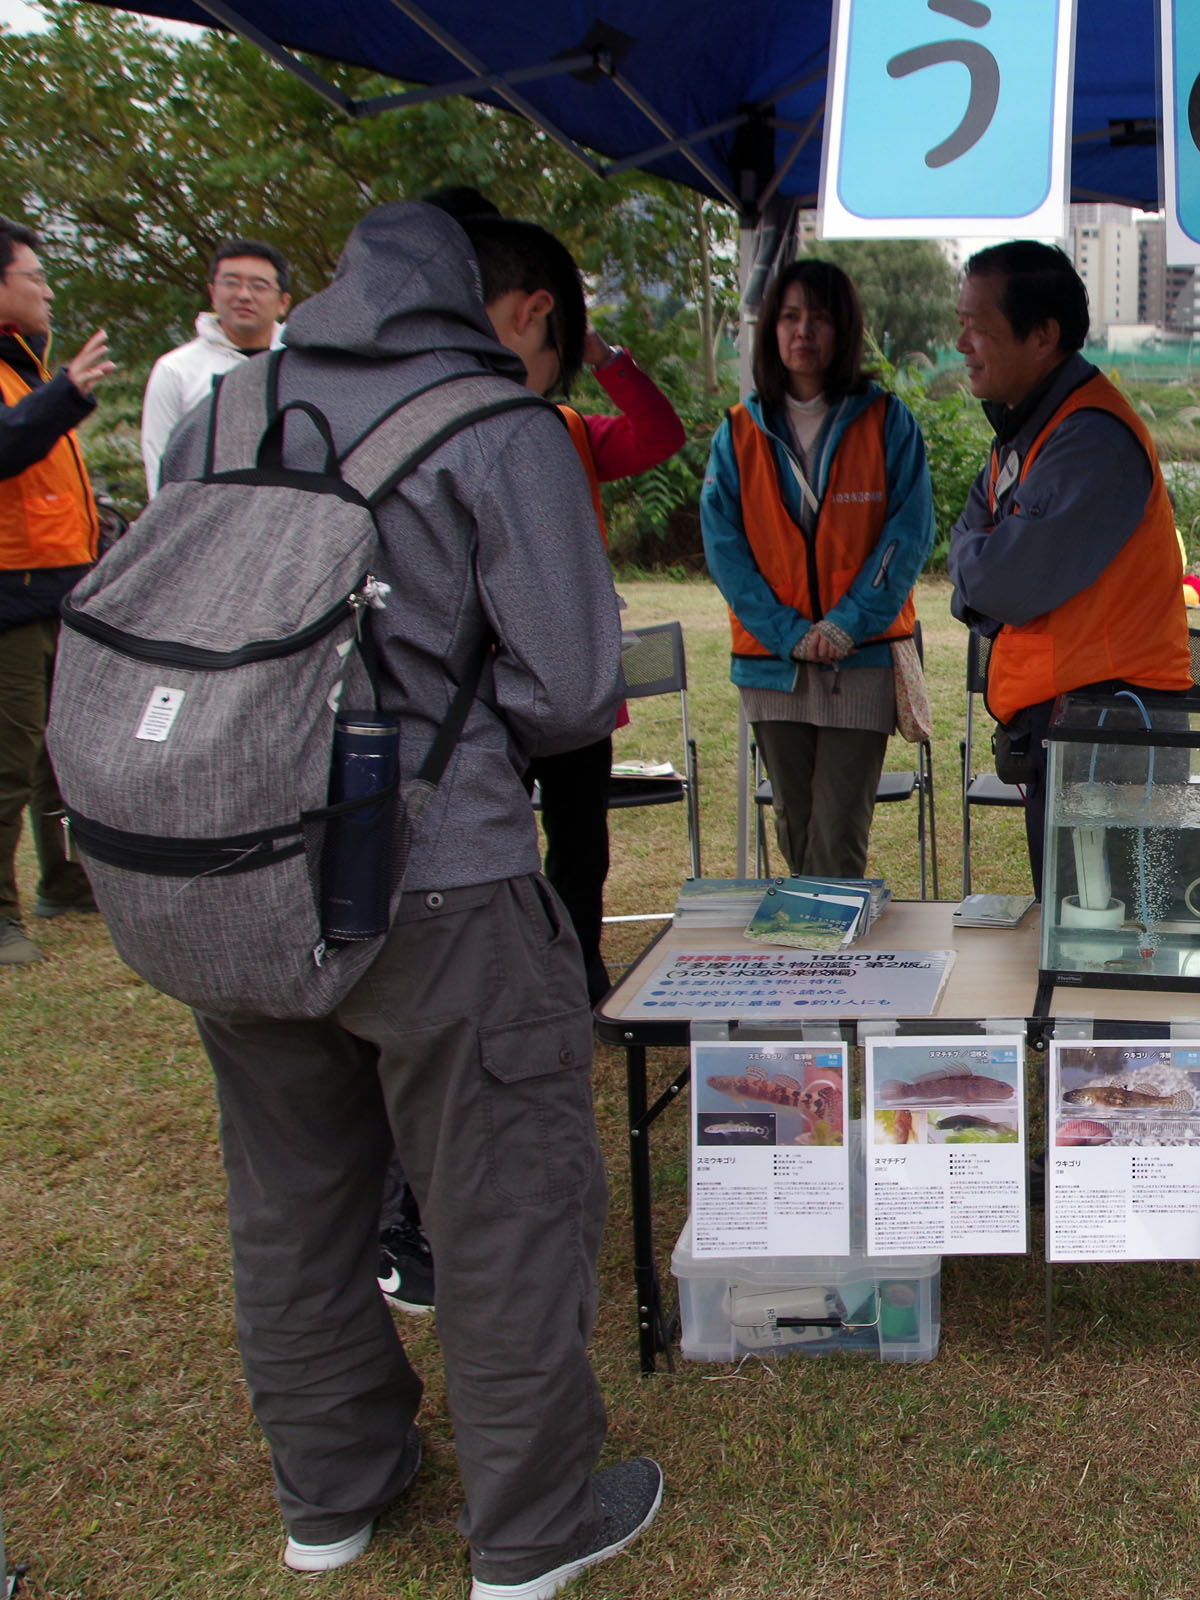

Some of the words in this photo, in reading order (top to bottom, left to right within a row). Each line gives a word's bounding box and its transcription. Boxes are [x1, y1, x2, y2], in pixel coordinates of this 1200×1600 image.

[887, 0, 1000, 169] う
[697, 1157, 736, 1165] スミウキゴリ
[874, 1157, 907, 1165] ヌマチチブ
